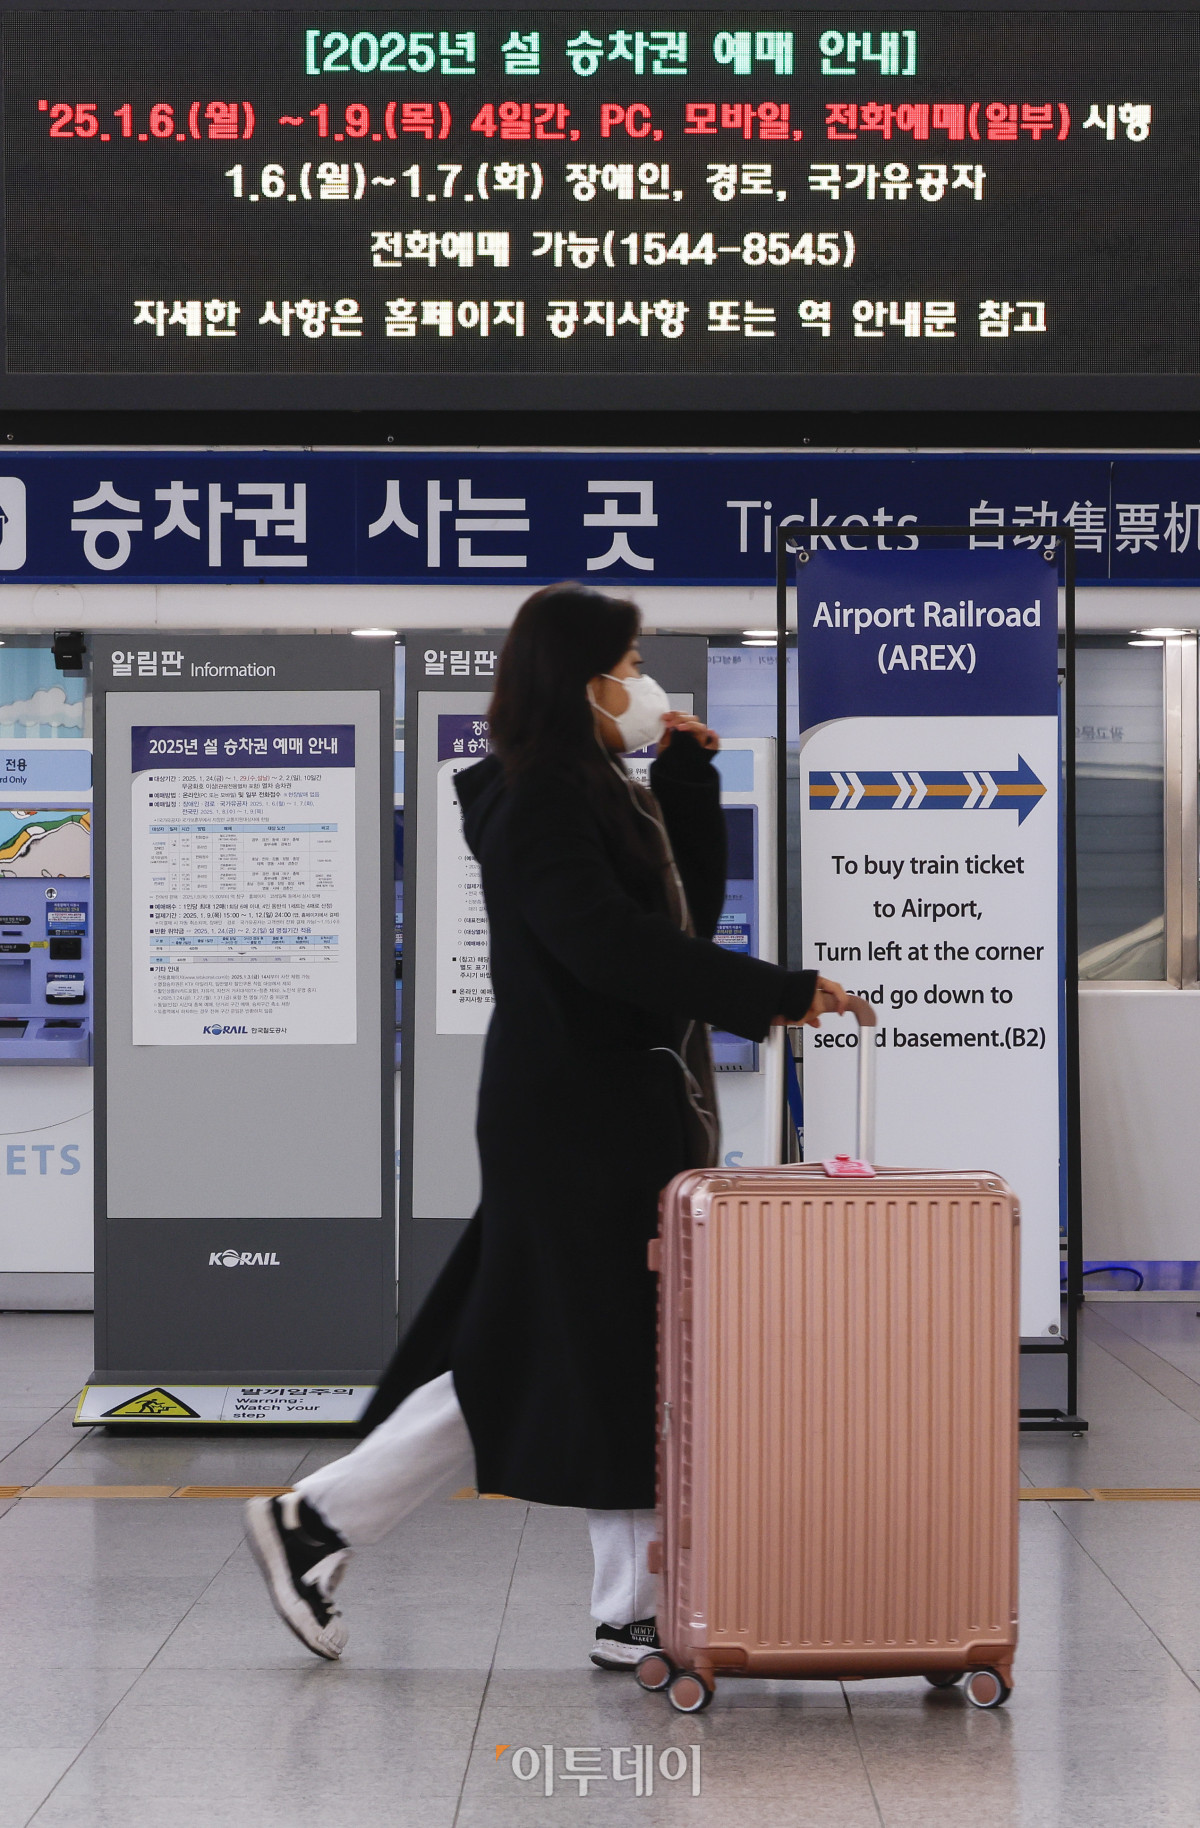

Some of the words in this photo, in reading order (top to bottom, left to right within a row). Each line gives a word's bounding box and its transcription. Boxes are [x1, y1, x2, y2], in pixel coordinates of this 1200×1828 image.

[306, 28, 476, 75] [2025년
[501, 30, 540, 74] 설
[566, 30, 688, 76] 승차권
[713, 30, 793, 75] 예매
[818, 29, 917, 75] 안내]
[37, 99, 255, 141] '25.1.6.(월)
[470, 101, 580, 141] 4일간,
[600, 102, 664, 141] PC,
[684, 101, 803, 141] 모바일,
[825, 101, 1071, 141] 전화예매(일부)
[1083, 101, 1152, 141] 시행
[565, 162, 683, 202] 장애인,
[706, 162, 787, 202] 경로,
[808, 162, 987, 202] 국가유공자
[370, 229, 510, 267] 전화예매
[133, 299, 241, 337] 자세한
[258, 298, 363, 338] 사항은
[384, 298, 524, 337] 홈페이지
[546, 299, 690, 339] 공지사항
[707, 299, 776, 337] 또는
[798, 300, 831, 337] 역
[852, 299, 957, 337] 안내문
[979, 300, 1047, 337] 참고
[71, 480, 308, 571] 승차권
[368, 479, 530, 568] 사는
[583, 480, 659, 571] 곳
[726, 498, 920, 553] Tickets
[813, 601, 915, 634] Airport
[924, 600, 1042, 628] Railroad
[111, 650, 184, 676] 알림판
[190, 662, 276, 677] Information
[424, 650, 497, 676] 알림판
[878, 643, 976, 674] (AREX)
[149, 739, 197, 755] 2025년
[204, 739, 217, 755] 설
[224, 739, 267, 755] 승차권
[273, 738, 302, 755] 예매
[309, 738, 337, 755] 안내
[453, 739, 463, 753] 설
[6, 758, 27, 771] 전용
[9, 776, 28, 787] Only
[831, 855, 858, 874] To
[864, 855, 904, 879] buy
[910, 854, 958, 874] train
[965, 854, 1025, 874] ticket
[873, 900, 896, 917] to
[901, 898, 983, 923] Airport,
[814, 942, 860, 961] Turn
[868, 941, 902, 961] left
[908, 943, 929, 961] at
[934, 941, 970, 961] the
[975, 946, 1044, 961] corner
[890, 990, 918, 1009] go
[924, 985, 984, 1004] down
[991, 987, 1013, 1004] to
[203, 1024, 248, 1035] KORAIL
[814, 1028, 886, 1052] secod
[893, 1027, 1046, 1053] basement.(B2)
[208, 1249, 281, 1268] KORAIL
[633, 1626, 653, 1636] MMY
